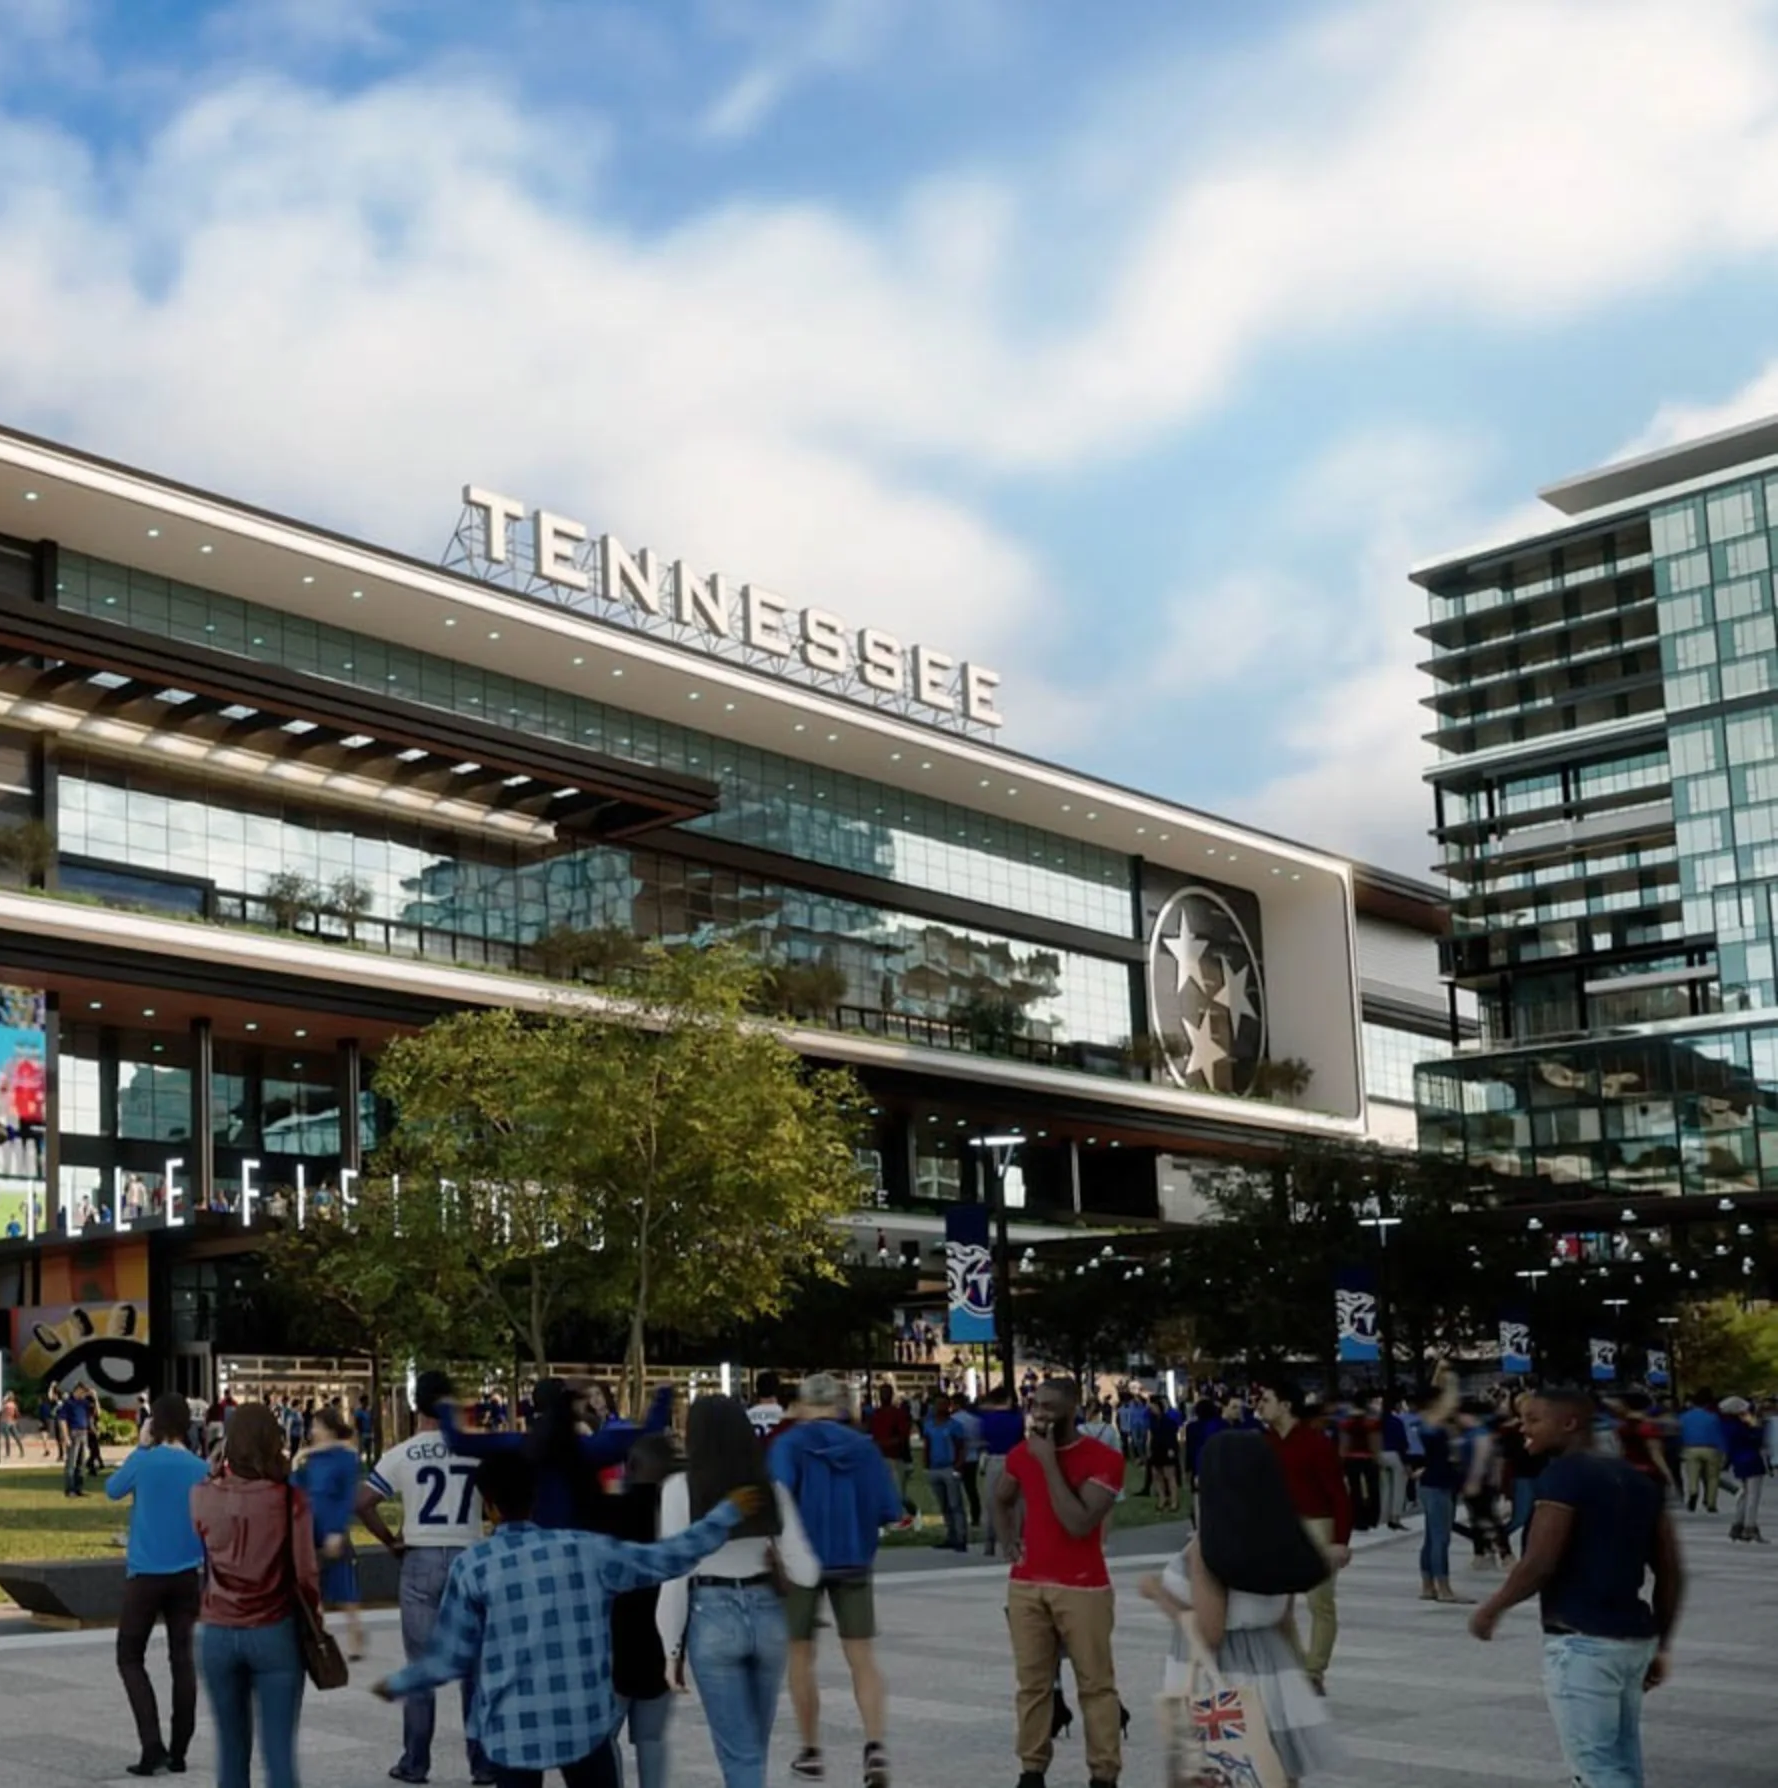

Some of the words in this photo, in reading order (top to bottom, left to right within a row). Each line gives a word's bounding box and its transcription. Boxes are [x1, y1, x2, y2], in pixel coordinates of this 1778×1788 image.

[462, 484, 1002, 728] TENNESSEE
[406, 1442, 456, 1461] GEO
[416, 1465, 480, 1525] 27
